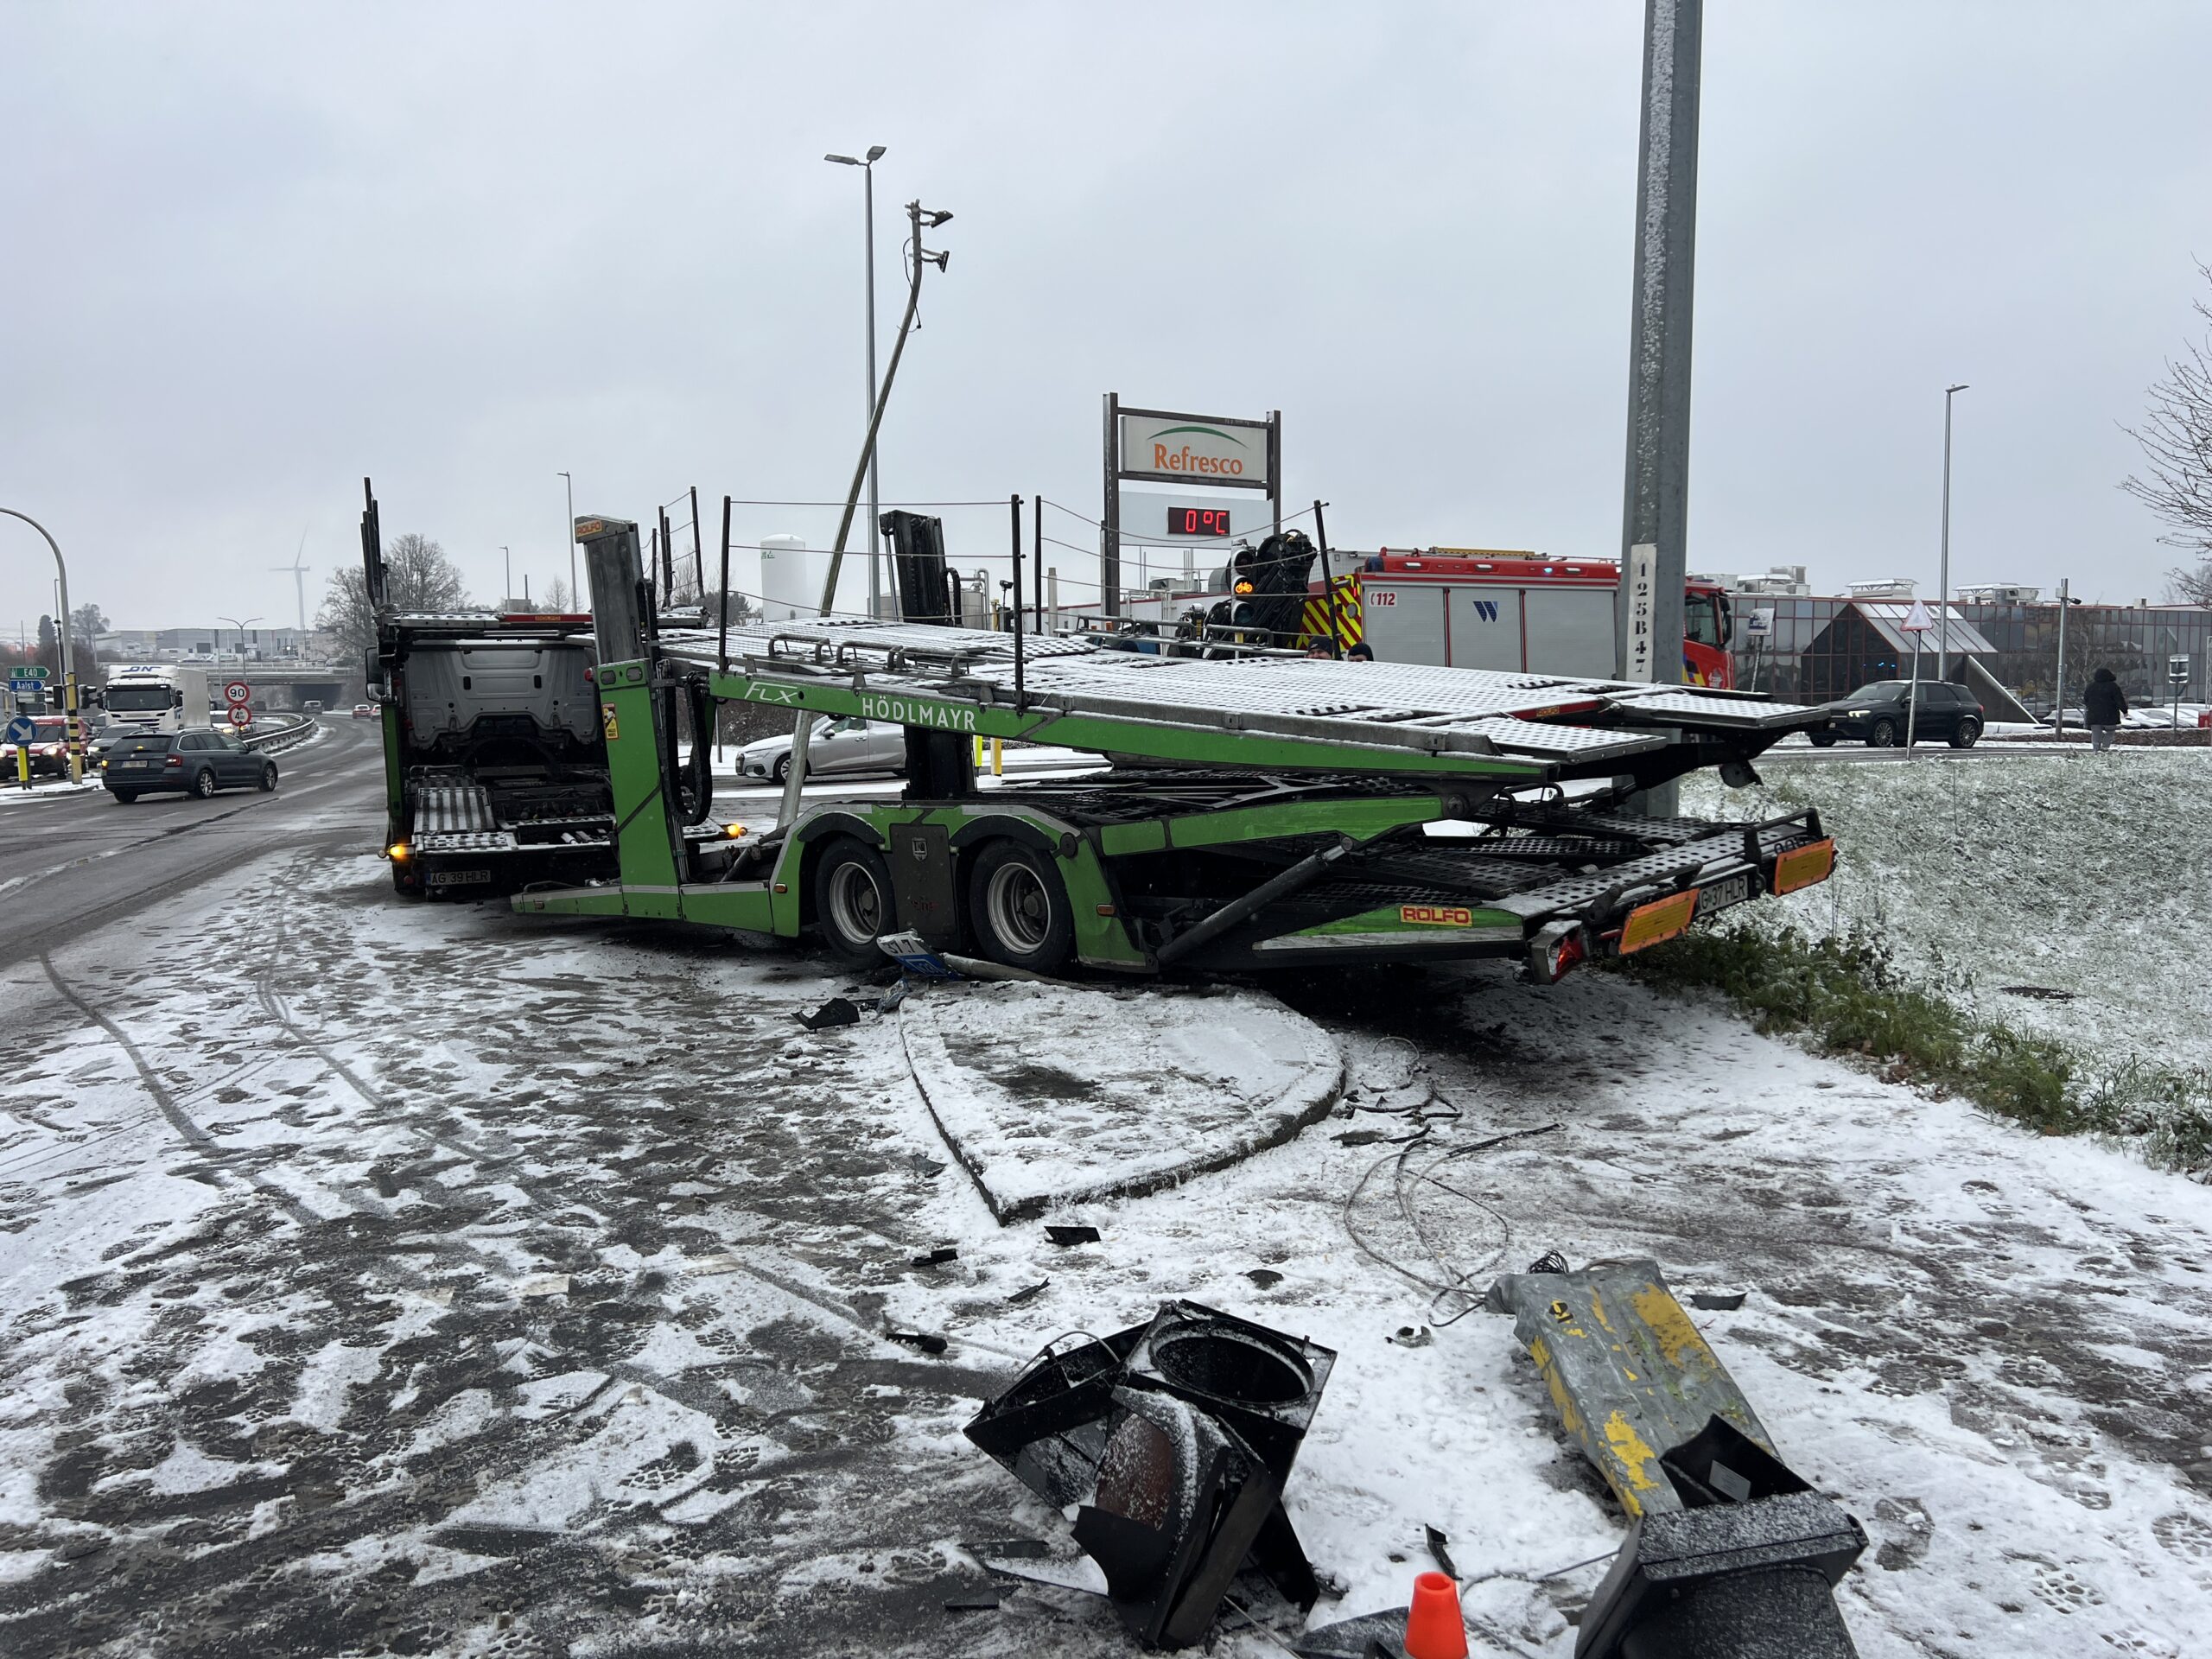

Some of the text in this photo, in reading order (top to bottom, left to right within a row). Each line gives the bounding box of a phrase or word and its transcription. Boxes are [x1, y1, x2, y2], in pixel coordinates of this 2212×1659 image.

[1154, 443, 1243, 475] Refresco
[1376, 593, 1395, 606] 112
[23, 668, 38, 677] E40
[230, 689, 245, 697] 90
[862, 696, 976, 731] HÖDLMAYR
[450, 872, 463, 883] 39
[467, 870, 488, 881] HLR
[1712, 885, 1723, 906] 37
[1726, 877, 1745, 901] HLR
[1402, 907, 1469, 924] ROLFO
